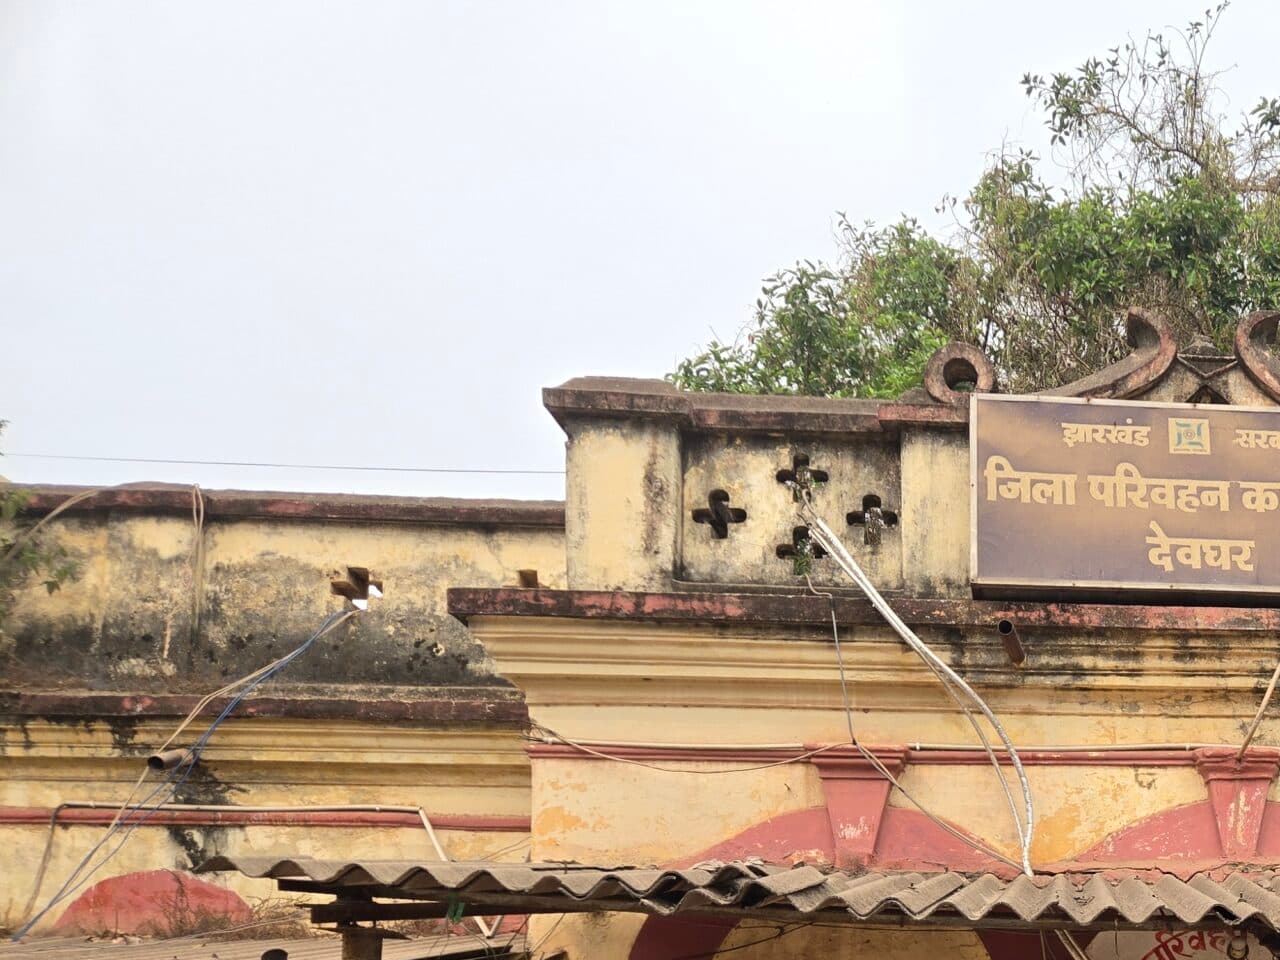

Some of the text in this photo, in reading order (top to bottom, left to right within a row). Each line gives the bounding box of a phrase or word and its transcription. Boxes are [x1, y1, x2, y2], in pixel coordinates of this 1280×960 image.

[1061, 417, 1151, 448] झारखंड
[984, 455, 1077, 506] जिला
[1087, 462, 1229, 513] परिवहन
[1145, 521, 1256, 572] देवघर
